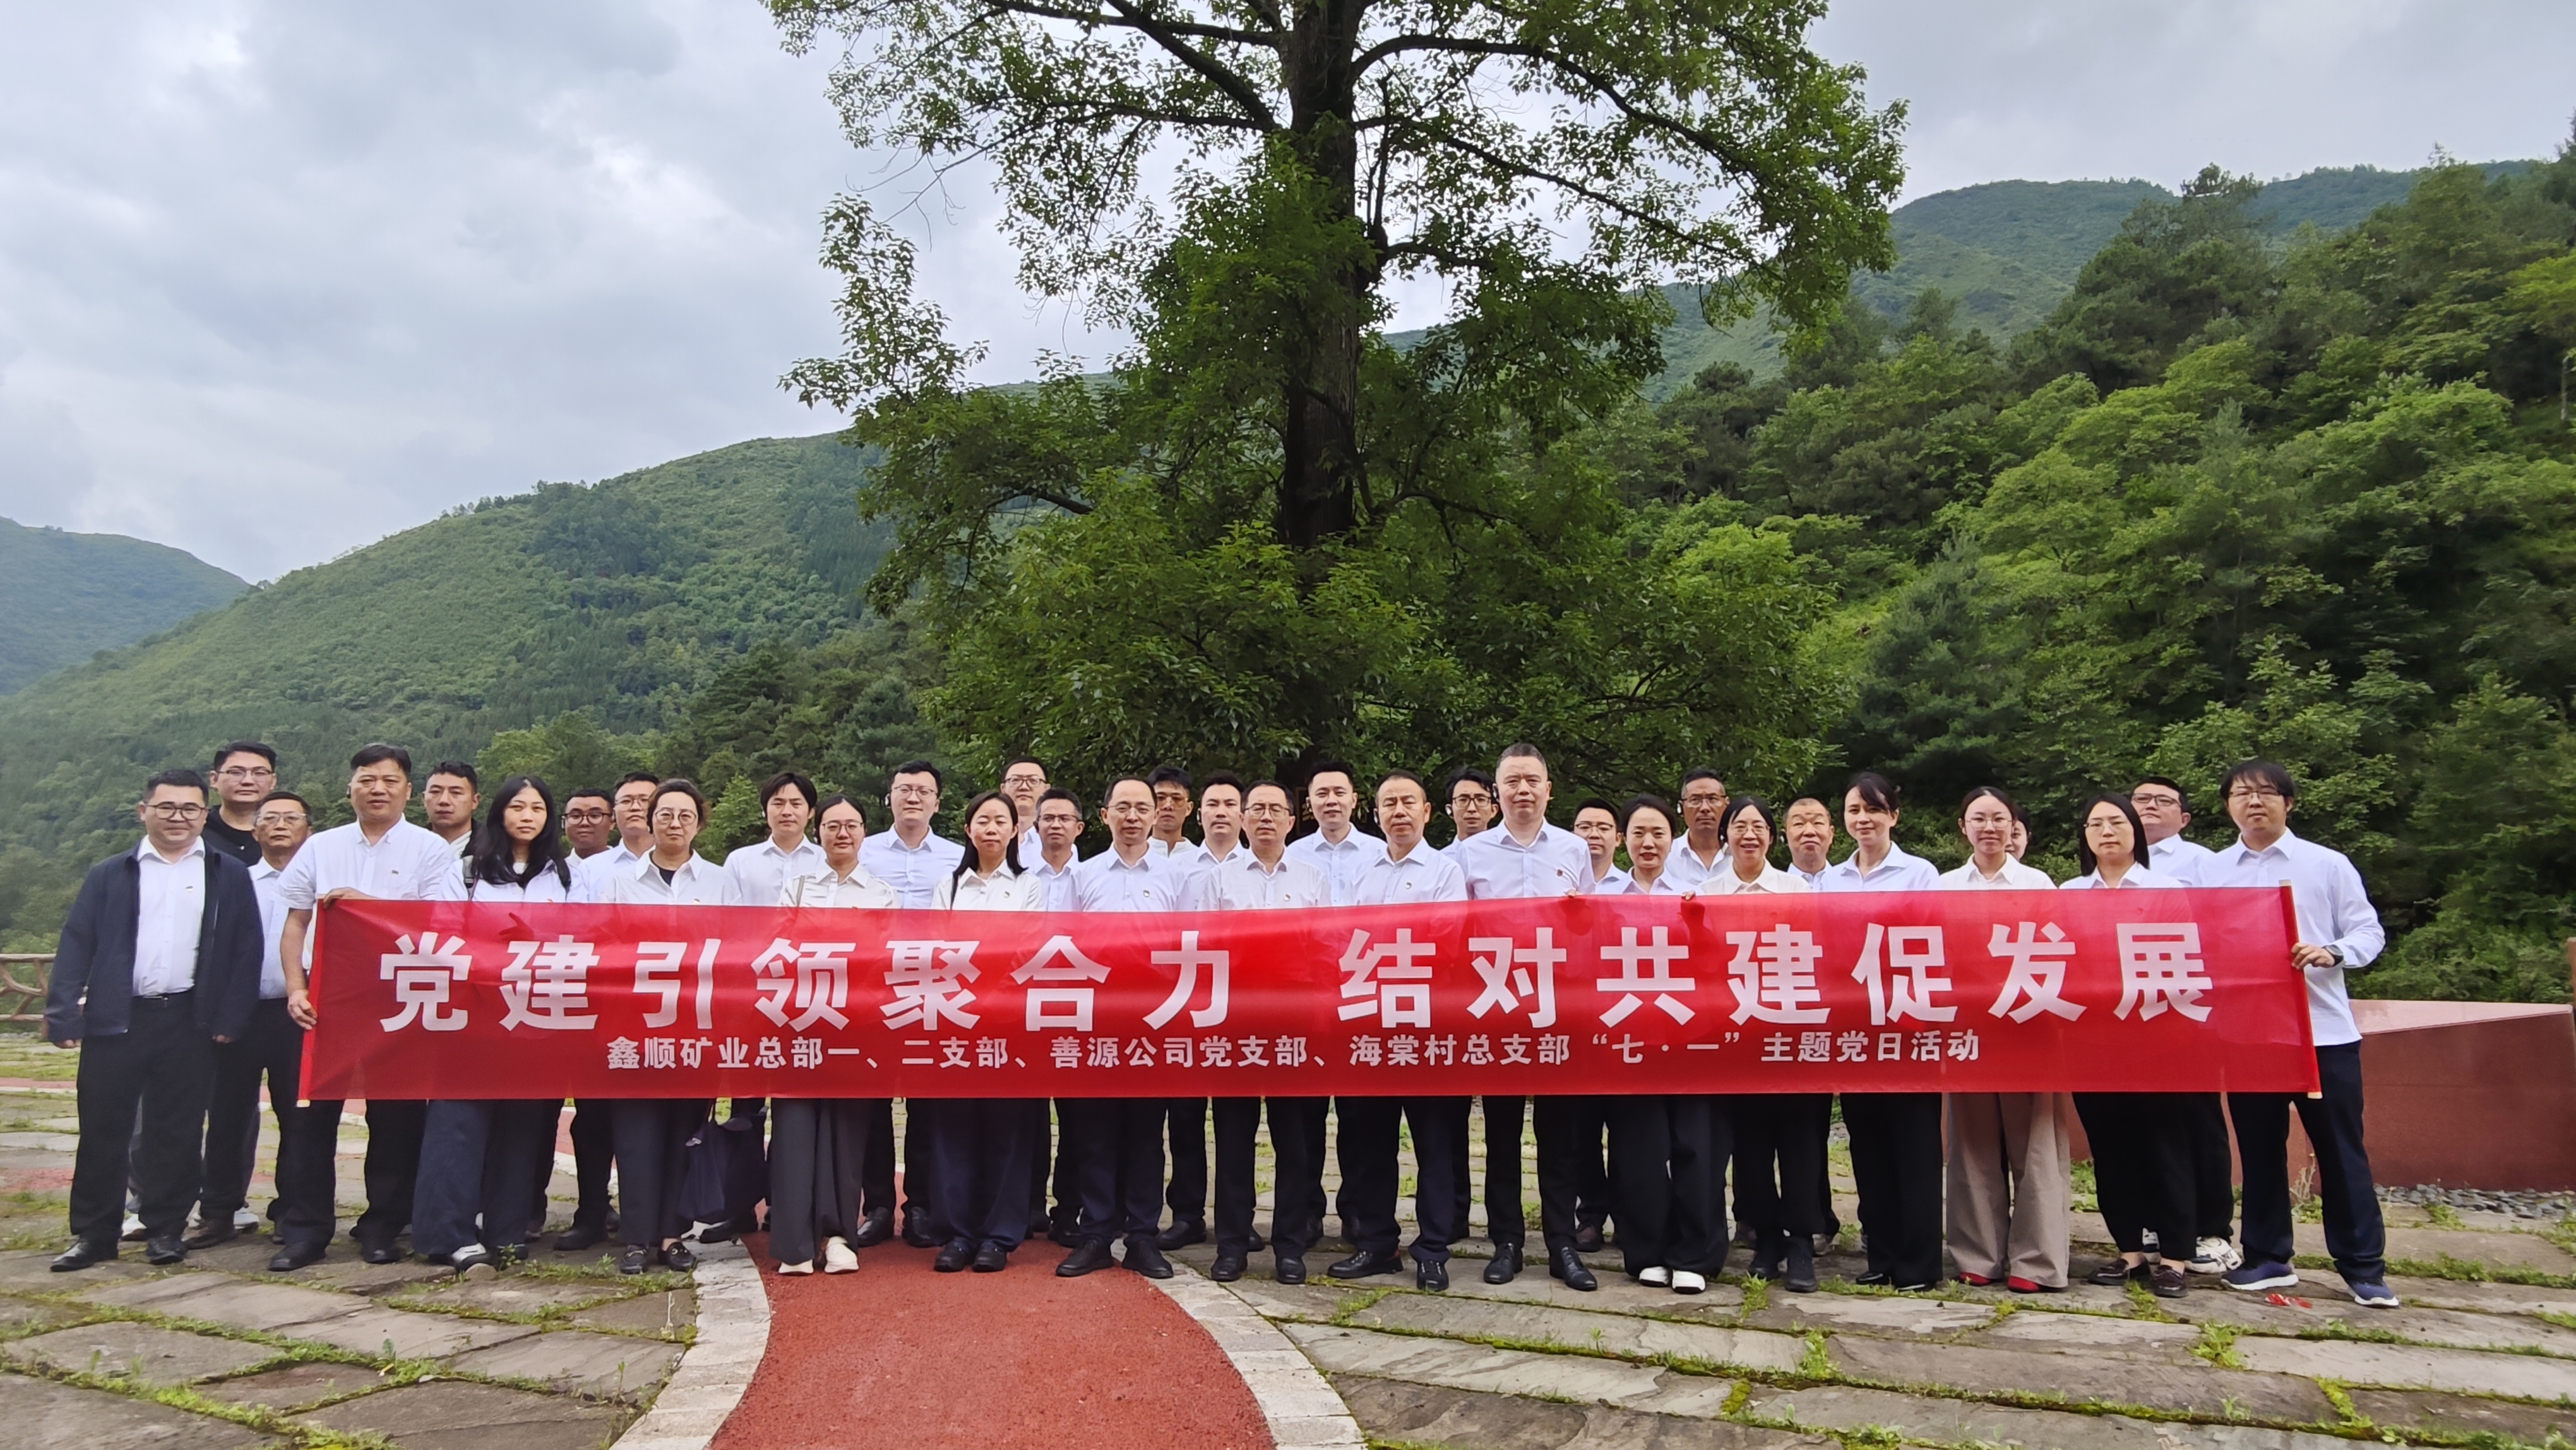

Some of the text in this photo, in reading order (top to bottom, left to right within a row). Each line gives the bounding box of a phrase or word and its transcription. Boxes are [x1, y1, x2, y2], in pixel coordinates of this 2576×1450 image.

[379, 920, 2214, 1033] 党建引领聚合力 结对共建促发展
